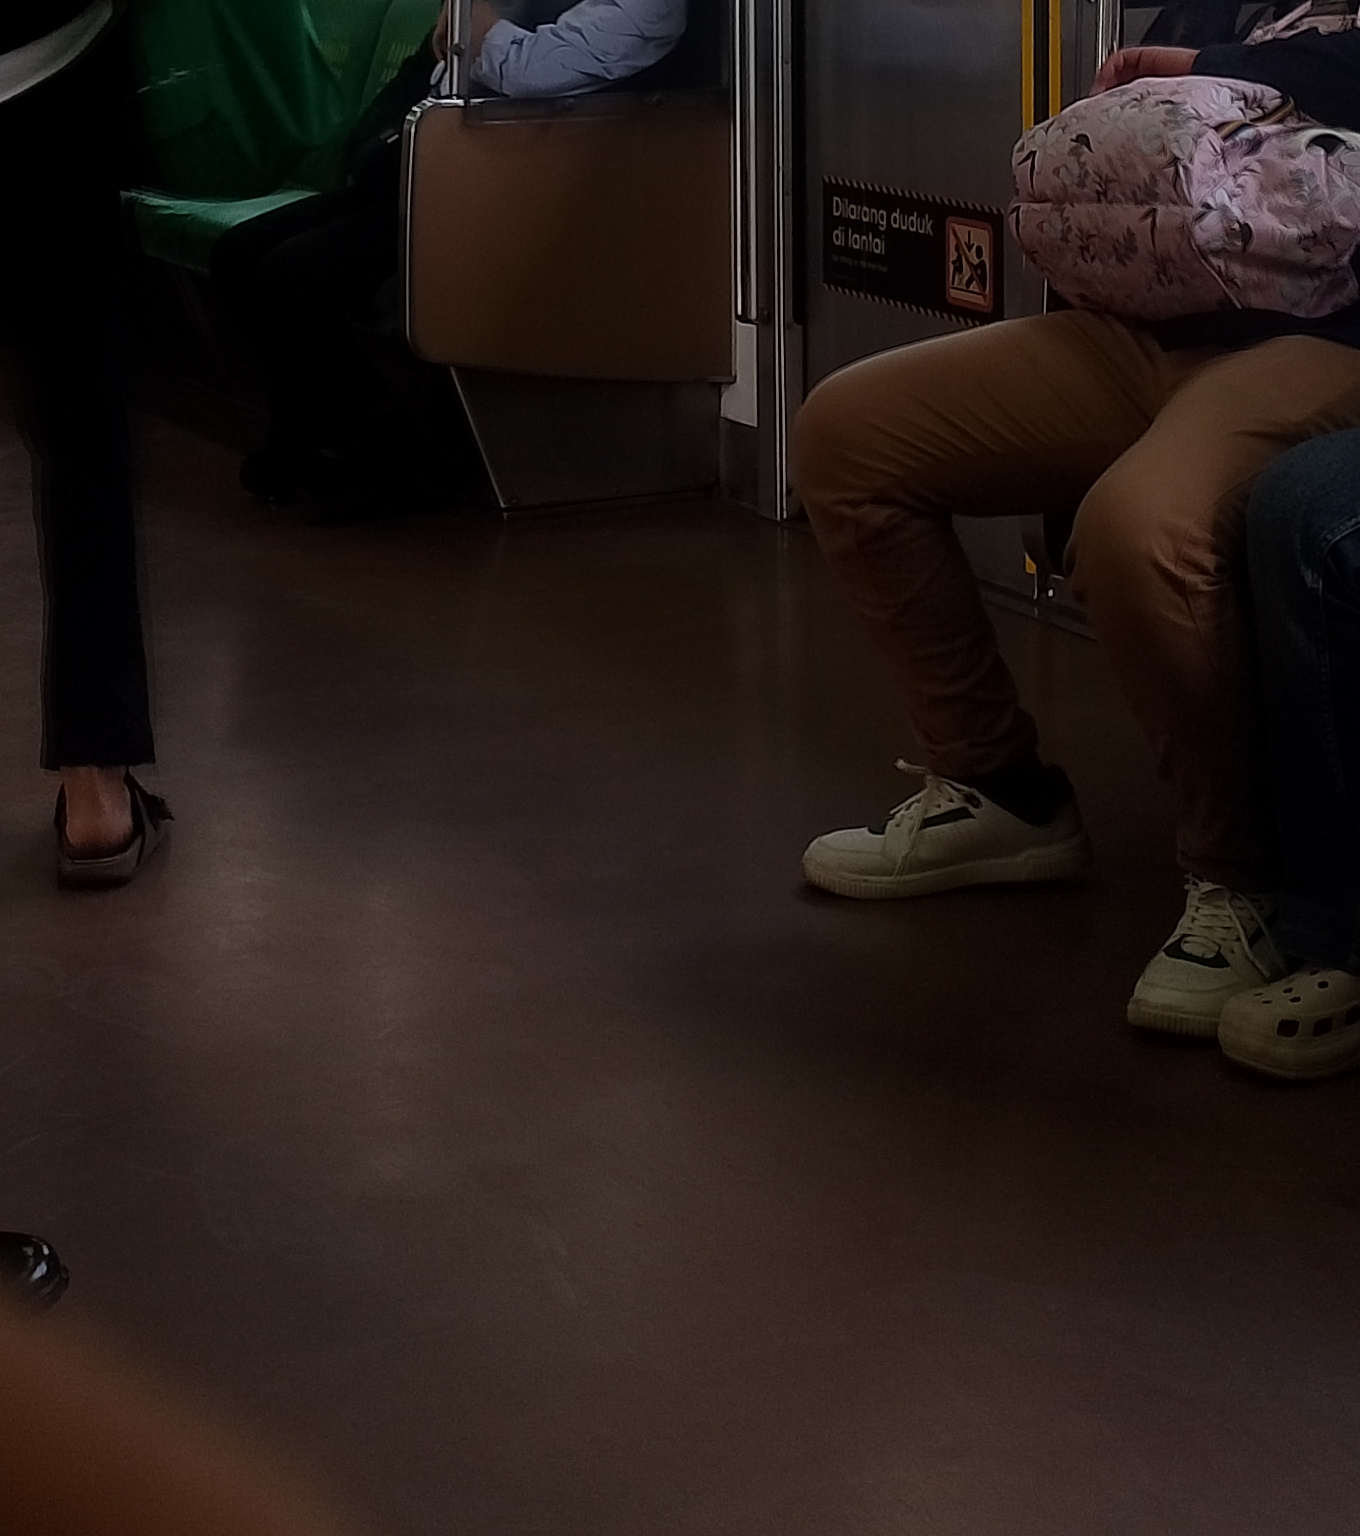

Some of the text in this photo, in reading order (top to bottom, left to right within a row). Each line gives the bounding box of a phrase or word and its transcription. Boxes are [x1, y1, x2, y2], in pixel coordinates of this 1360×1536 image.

[832, 196, 934, 236] Dilarang duduk
[832, 226, 886, 256] di lantai
